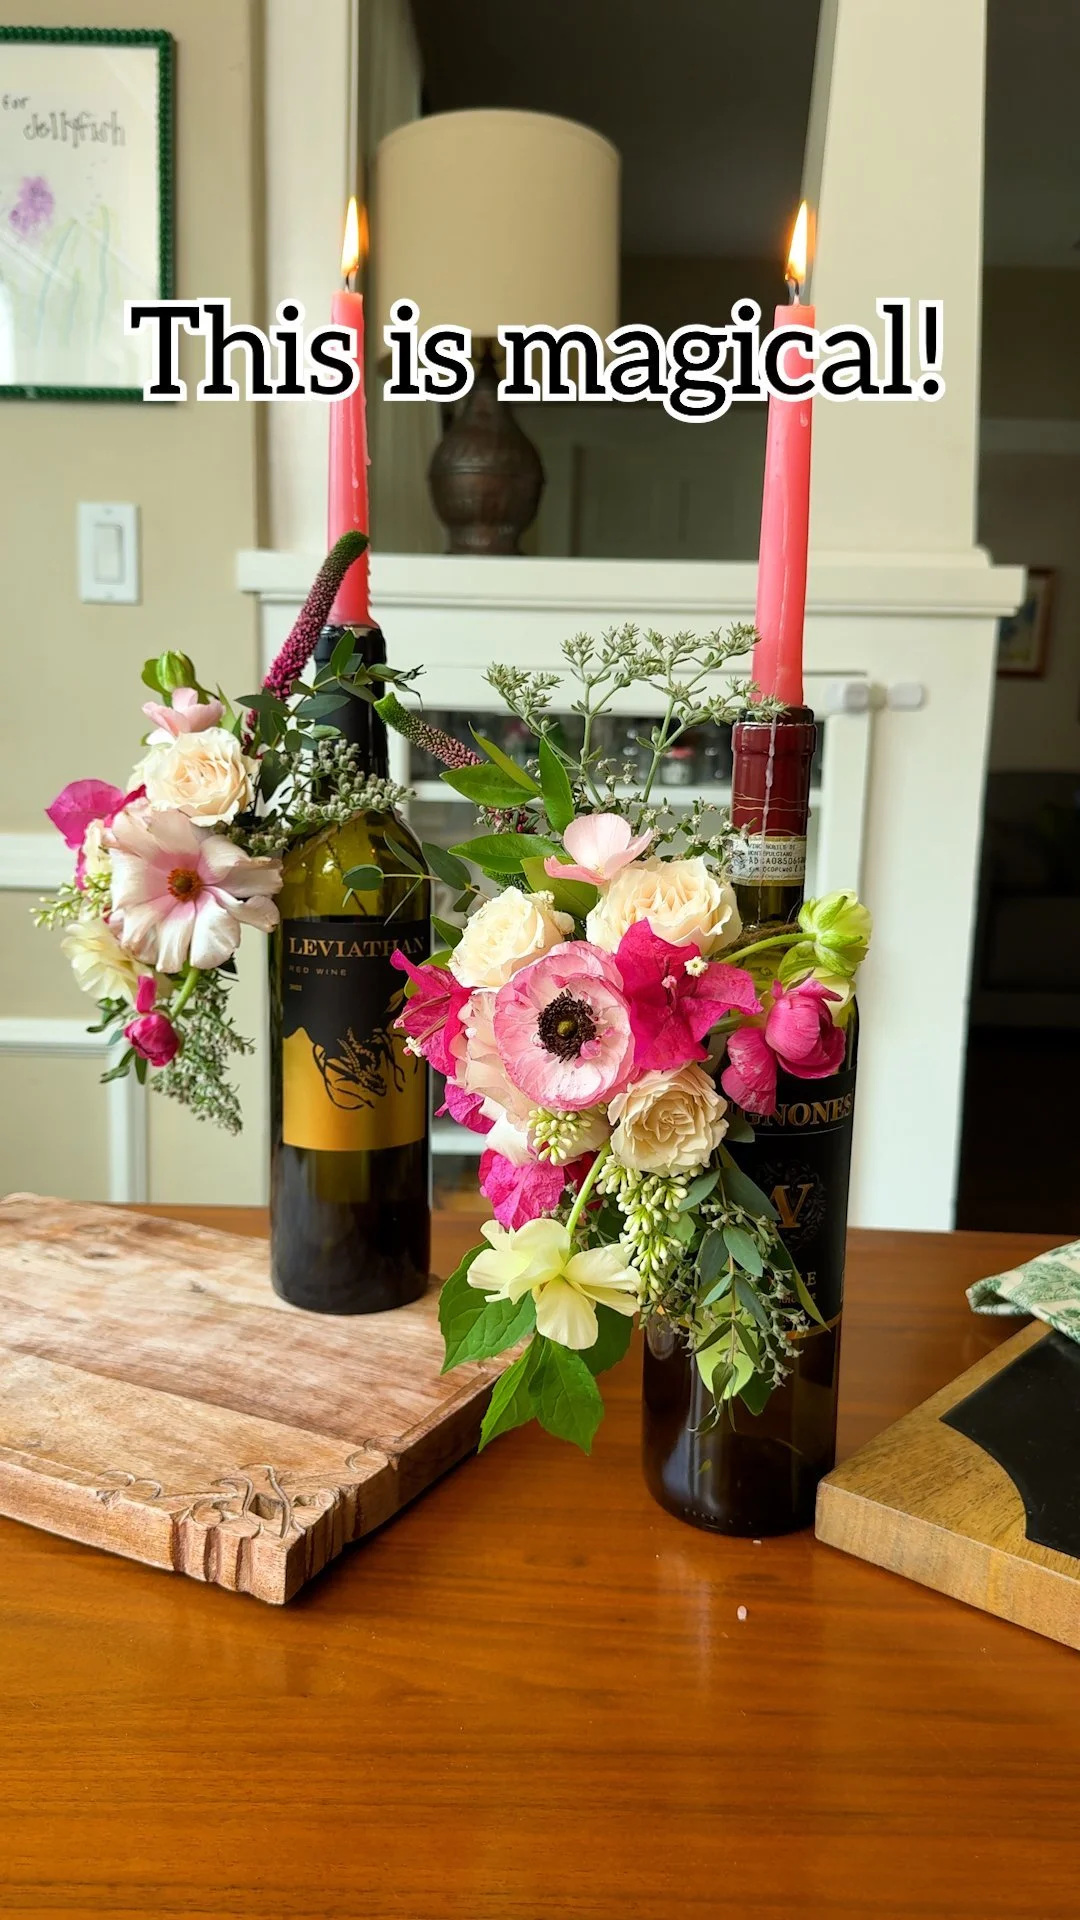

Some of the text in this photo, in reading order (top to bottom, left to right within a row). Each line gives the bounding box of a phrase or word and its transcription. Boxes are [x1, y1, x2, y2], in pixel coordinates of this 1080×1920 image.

[1, 94, 30, 110] for
[289, 936, 424, 958] LEVIATHAN
[288, 965, 347, 977] RED WINE
